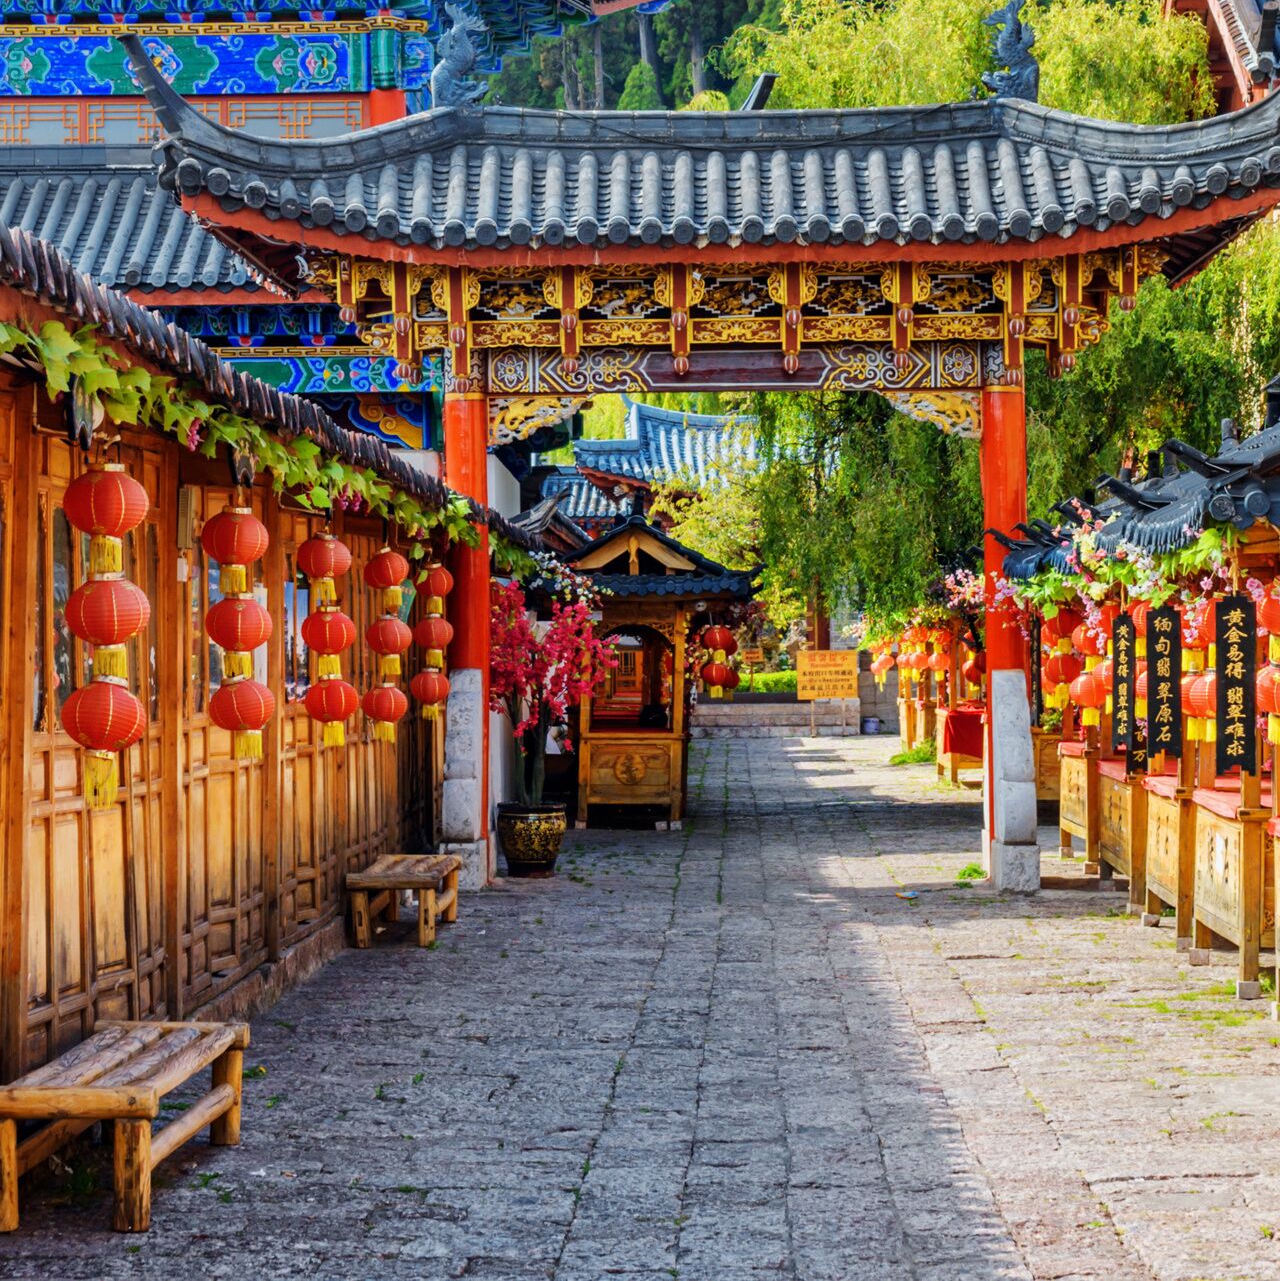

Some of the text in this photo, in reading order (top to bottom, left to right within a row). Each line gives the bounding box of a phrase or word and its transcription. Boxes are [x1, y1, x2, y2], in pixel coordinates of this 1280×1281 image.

[1153, 616, 1174, 743] 缅甸翡翠原石
